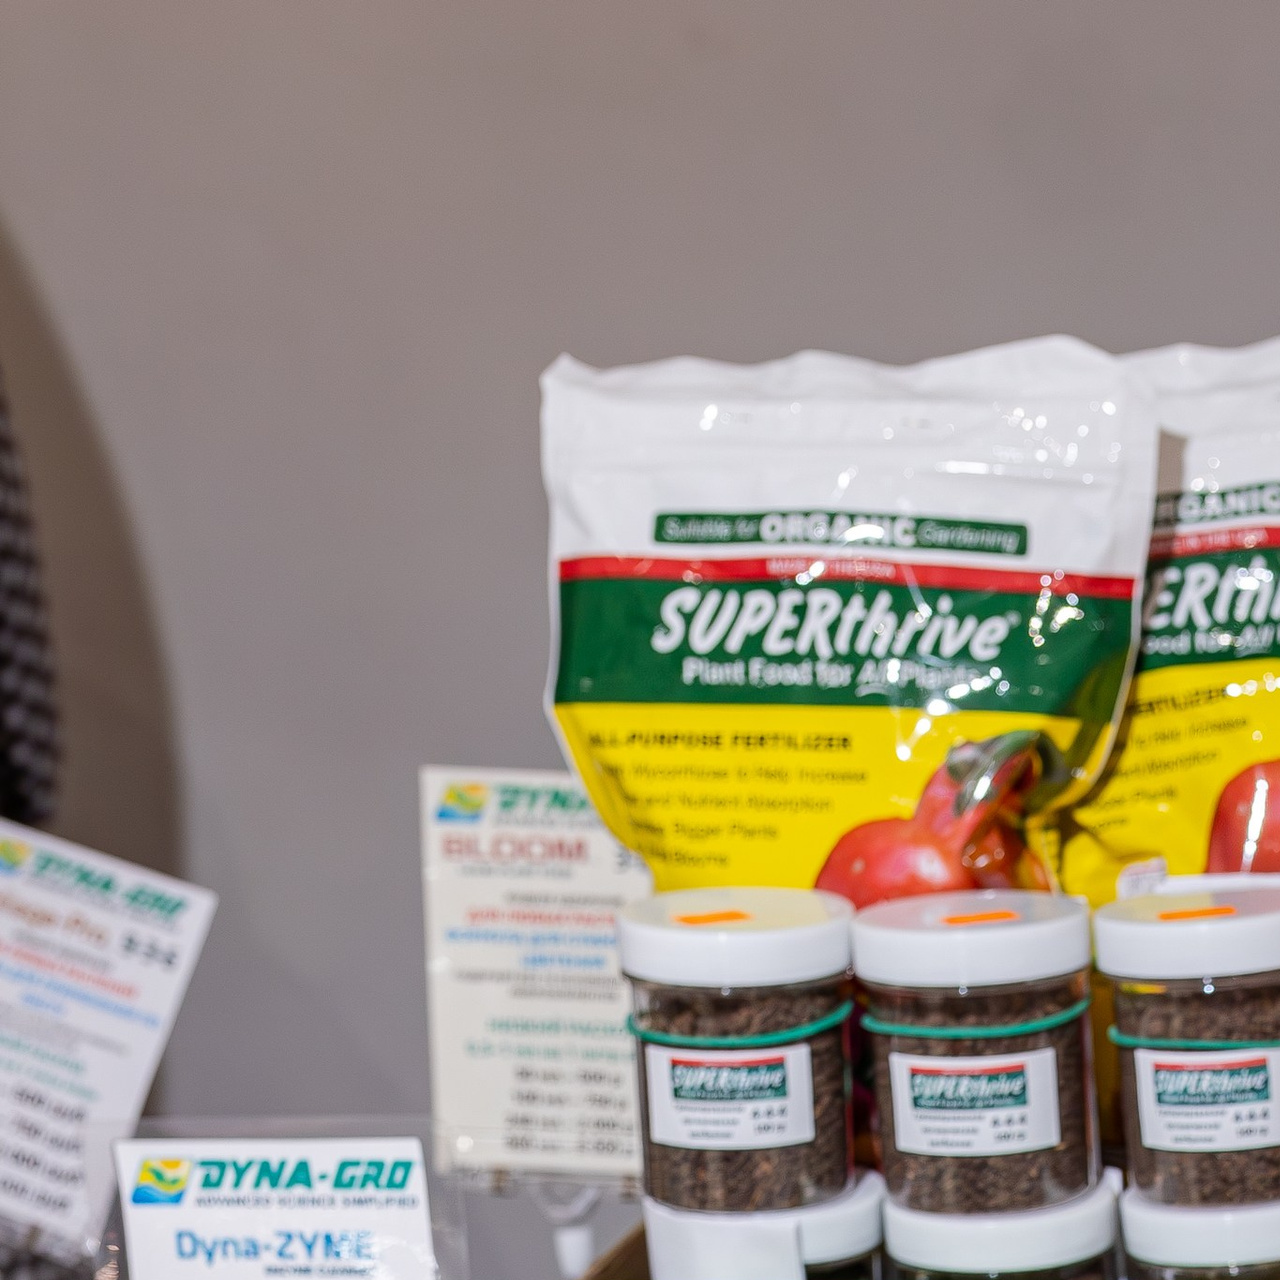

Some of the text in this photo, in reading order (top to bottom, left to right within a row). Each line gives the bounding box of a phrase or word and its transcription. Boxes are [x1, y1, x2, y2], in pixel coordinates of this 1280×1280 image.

[760, 514, 917, 547] ORGANIC
[651, 587, 1010, 660] SUPERthrive
[682, 658, 745, 687] Plant
[751, 660, 812, 688] Food
[816, 660, 852, 688] for
[195, 1159, 416, 1190] DYNA-GRO
[176, 1230, 376, 1267] Dyna-ZYME
